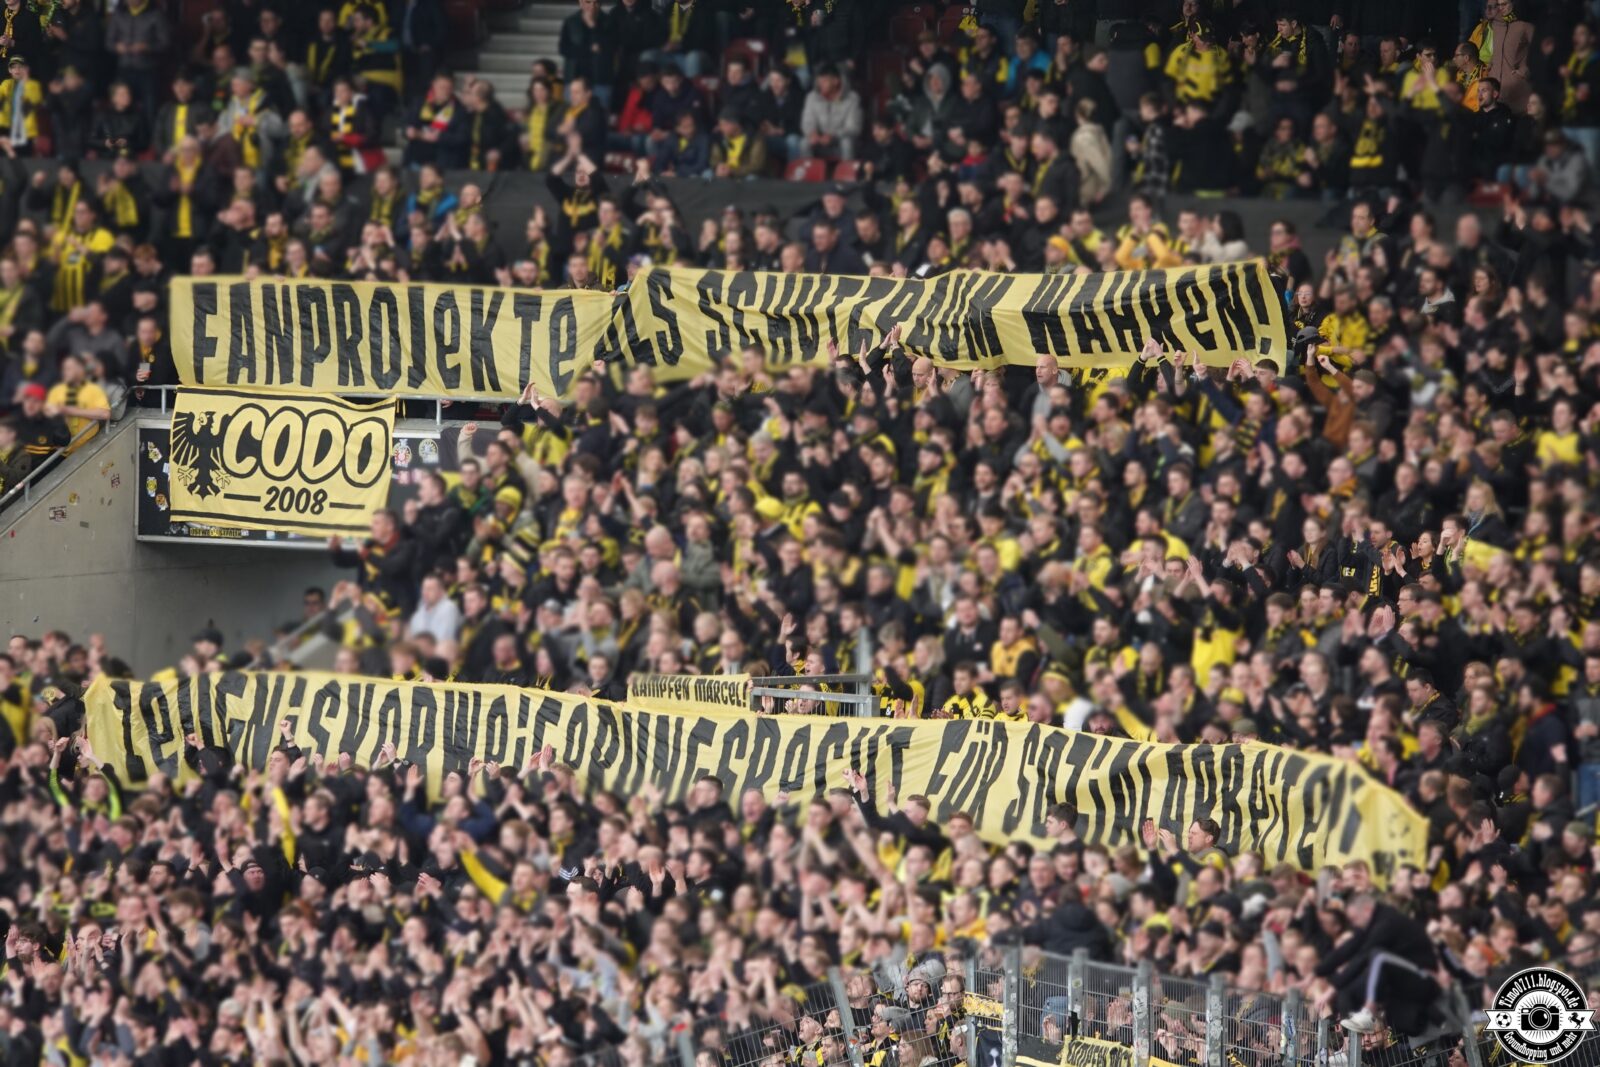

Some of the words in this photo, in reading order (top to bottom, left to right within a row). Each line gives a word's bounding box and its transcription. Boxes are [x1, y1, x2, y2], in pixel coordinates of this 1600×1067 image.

[594, 268, 683, 366] ALS
[697, 269, 1015, 363] SCHUTZRAUM
[222, 403, 389, 488] CODO
[263, 486, 328, 515] 2008
[925, 719, 1008, 830] FÜR
